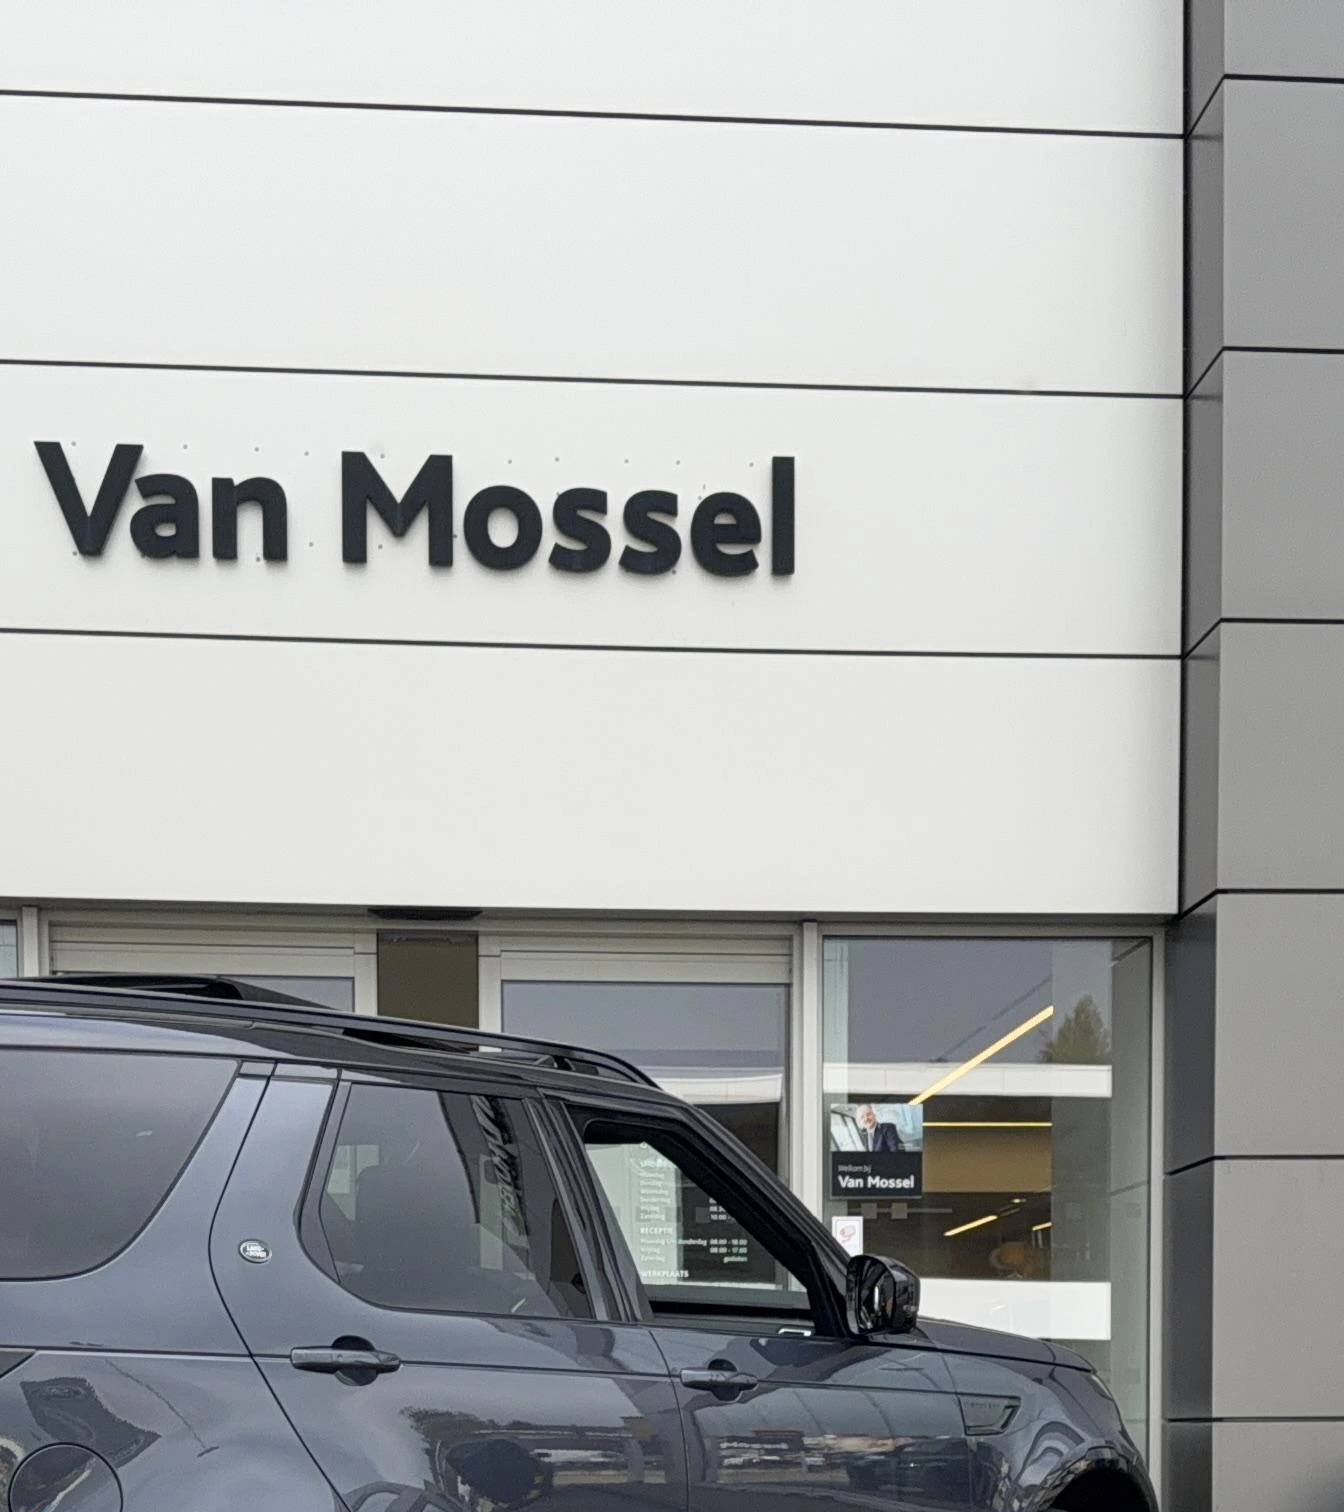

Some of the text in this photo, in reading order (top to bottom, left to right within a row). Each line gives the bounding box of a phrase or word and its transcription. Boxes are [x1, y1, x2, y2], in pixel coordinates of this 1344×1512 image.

[32, 440, 797, 577] Van Mossel
[837, 1174, 915, 1189] Van Mossel
